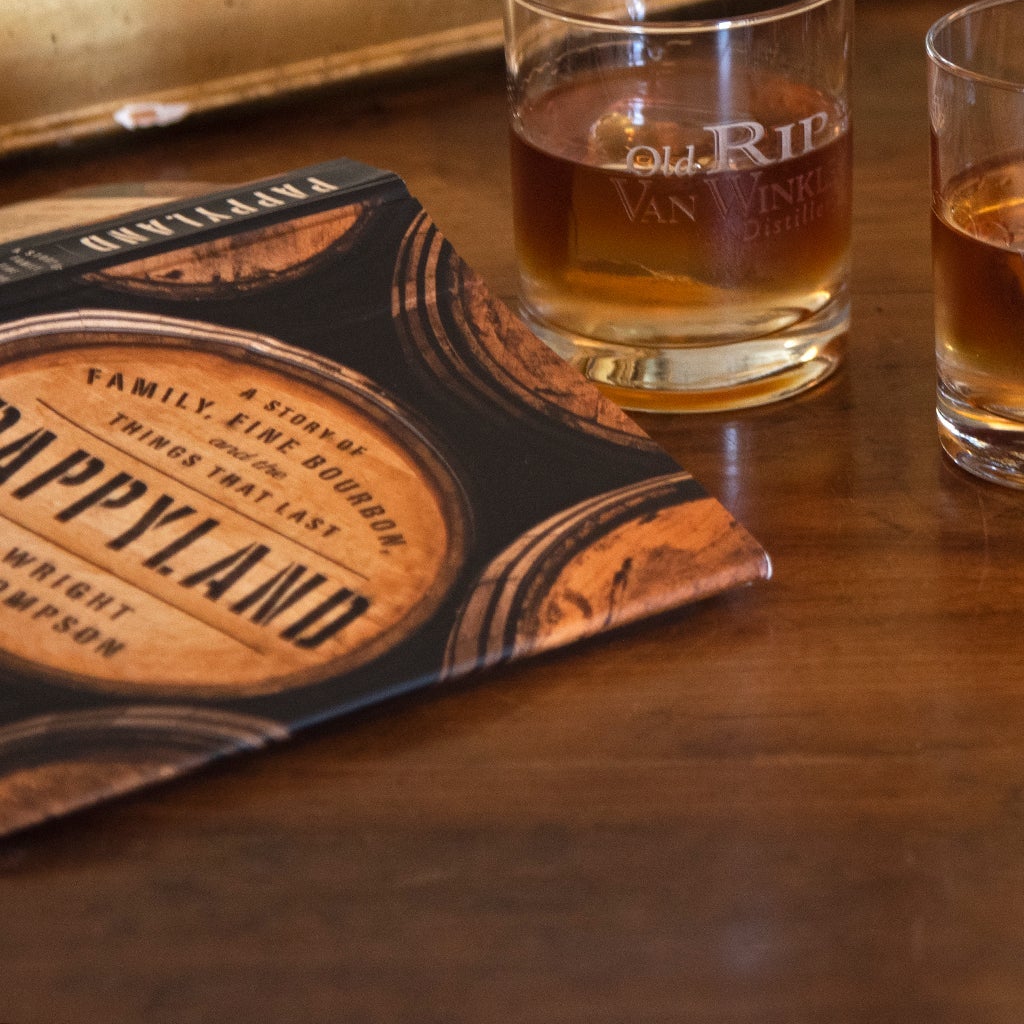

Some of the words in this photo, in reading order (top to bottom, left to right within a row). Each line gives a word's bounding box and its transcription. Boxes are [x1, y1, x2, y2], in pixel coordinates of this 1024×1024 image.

[626, 144, 697, 177] Old
[703, 111, 829, 176] RIP
[79, 175, 342, 253] PAPPYLAND
[609, 178, 696, 225] VAN
[703, 167, 833, 222] WINKL
[239, 387, 258, 401] A
[263, 399, 336, 440] STORY
[336, 437, 368, 457] OF
[85, 367, 215, 421] FAMILY,
[226, 412, 302, 456] FINE
[301, 454, 408, 556] BOURBON,
[108, 411, 203, 468] THINGS
[207, 465, 274, 503] THAT
[274, 501, 341, 539] LAST
[208, 437, 258, 463] and
[251, 459, 288, 481] the
[2, 546, 136, 622] WRIGHT
